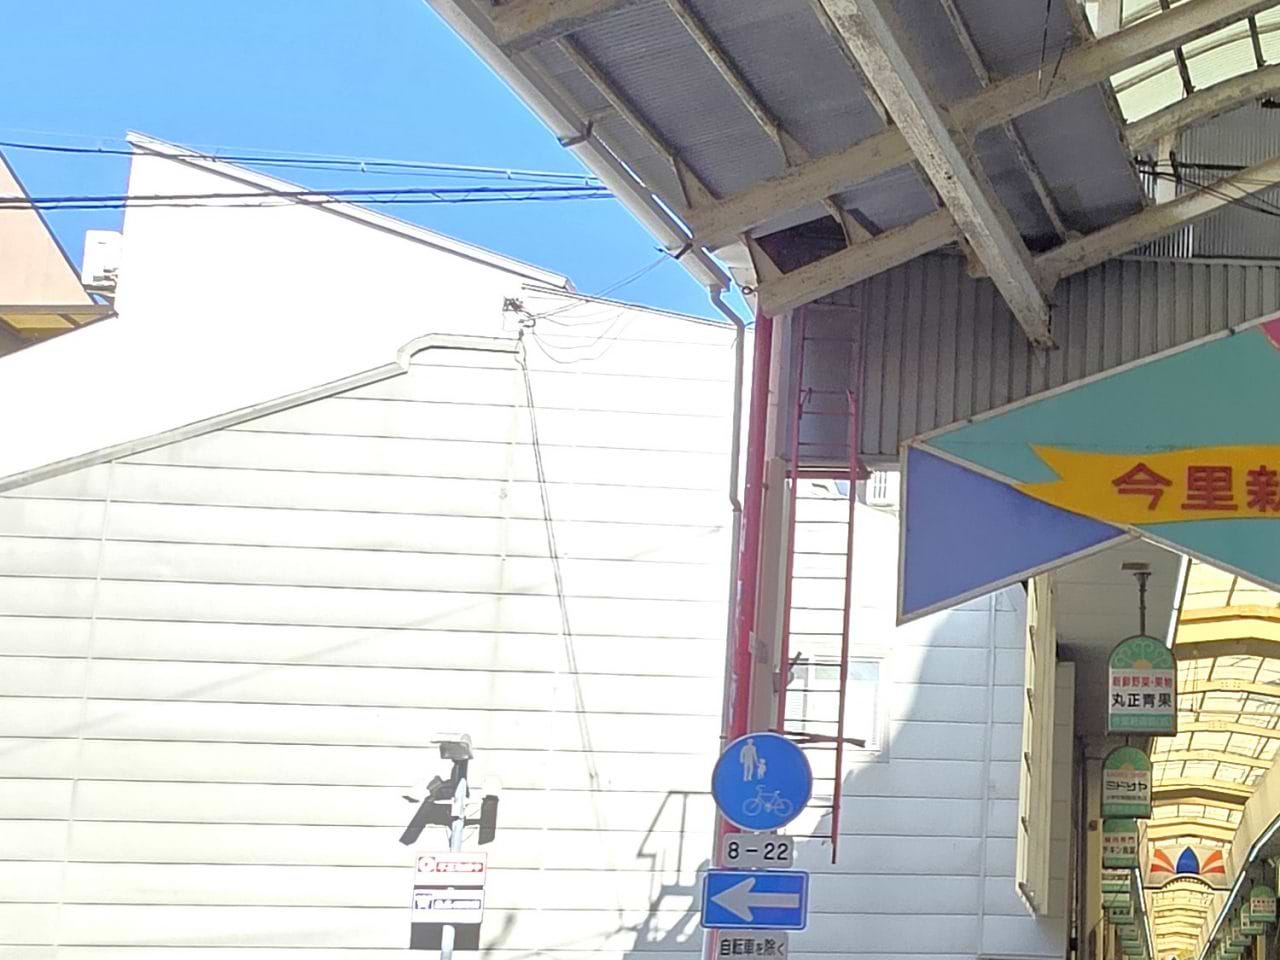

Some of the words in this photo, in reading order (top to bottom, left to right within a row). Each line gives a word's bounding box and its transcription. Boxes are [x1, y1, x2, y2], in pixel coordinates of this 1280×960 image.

[1112, 692, 1172, 708] 丸正青果
[720, 938, 784, 956] 自転車を除く
